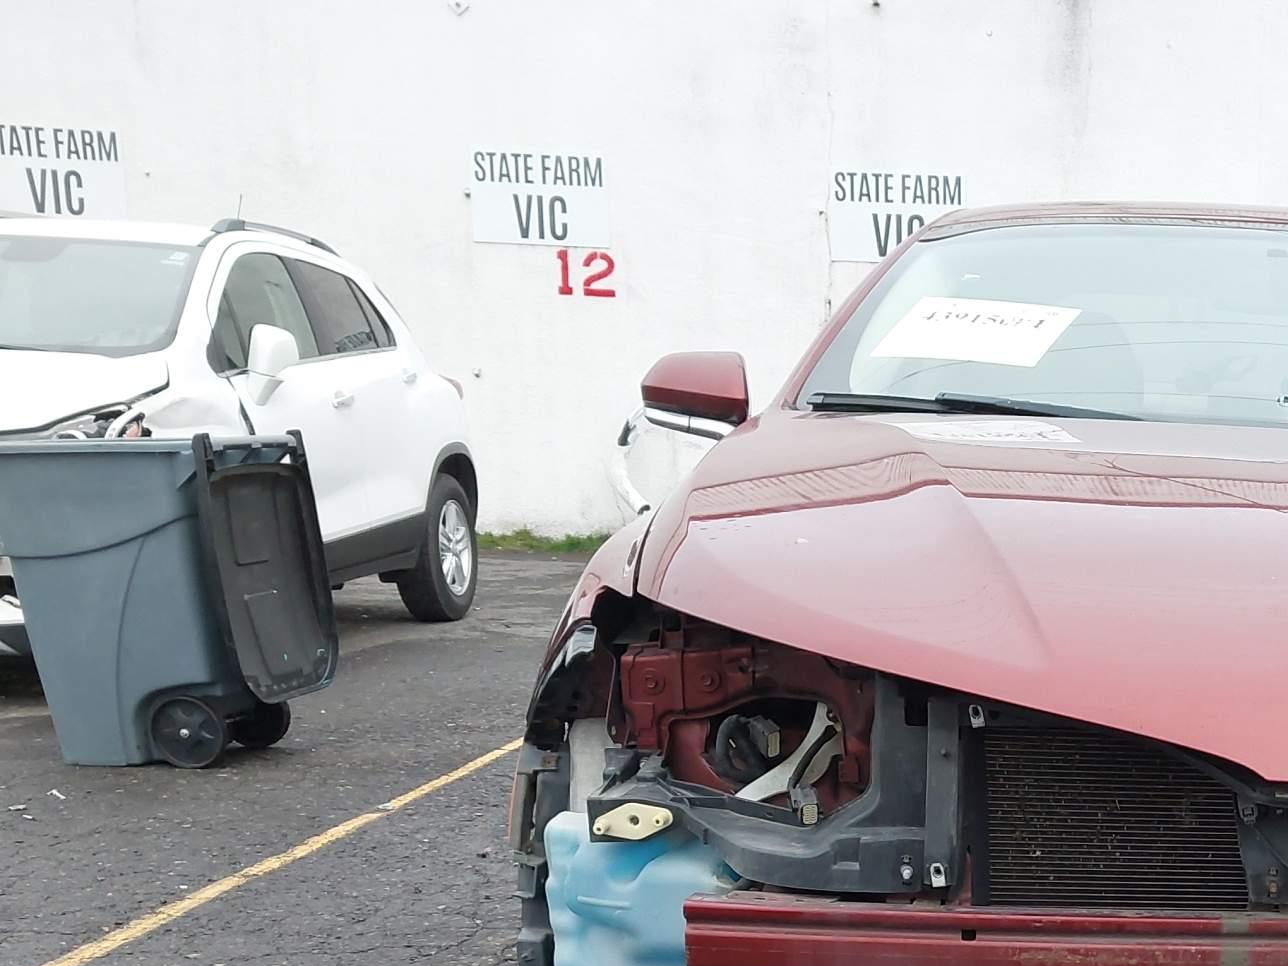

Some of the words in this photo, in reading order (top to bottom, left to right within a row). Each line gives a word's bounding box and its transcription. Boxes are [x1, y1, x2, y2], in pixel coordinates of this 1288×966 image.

[0, 124, 48, 159] TATE
[52, 128, 119, 162] FARM
[473, 151, 535, 185] STATE
[540, 154, 603, 188] FARM
[834, 171, 895, 204] STATE
[901, 174, 962, 206] FARM
[25, 167, 85, 216] VIC
[512, 193, 568, 241] VIC
[556, 249, 617, 298] 12
